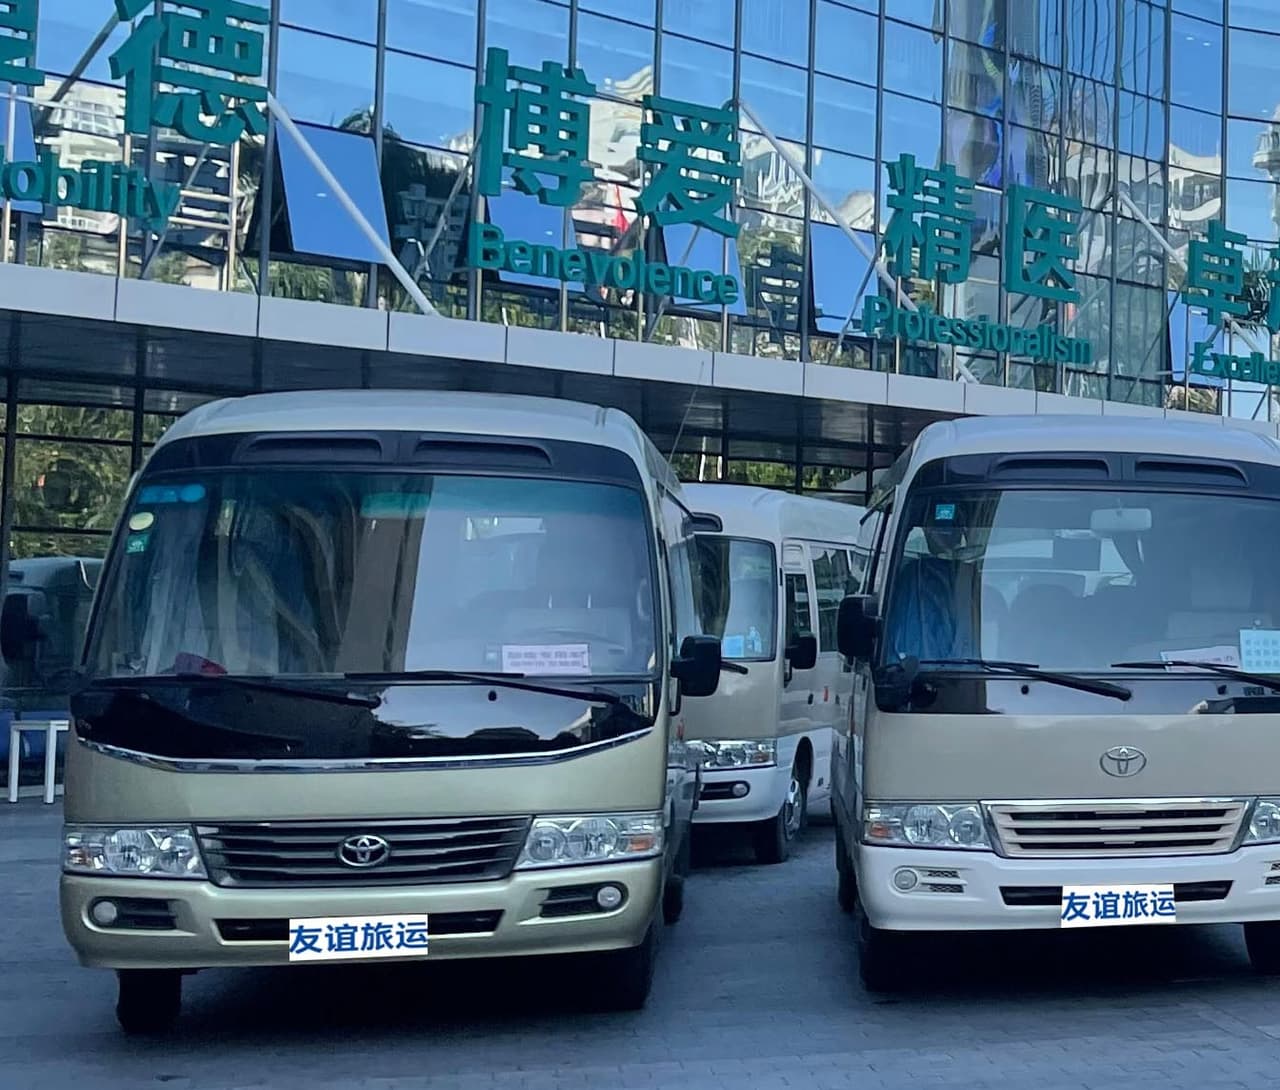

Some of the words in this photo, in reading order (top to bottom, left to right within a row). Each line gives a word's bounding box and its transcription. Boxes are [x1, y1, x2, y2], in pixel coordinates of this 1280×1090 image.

[475, 46, 743, 239] 博爱
[0, 146, 182, 236] obility
[884, 152, 1083, 303] 精医
[467, 222, 741, 305] Benevolence
[862, 294, 1094, 364] Professionalism
